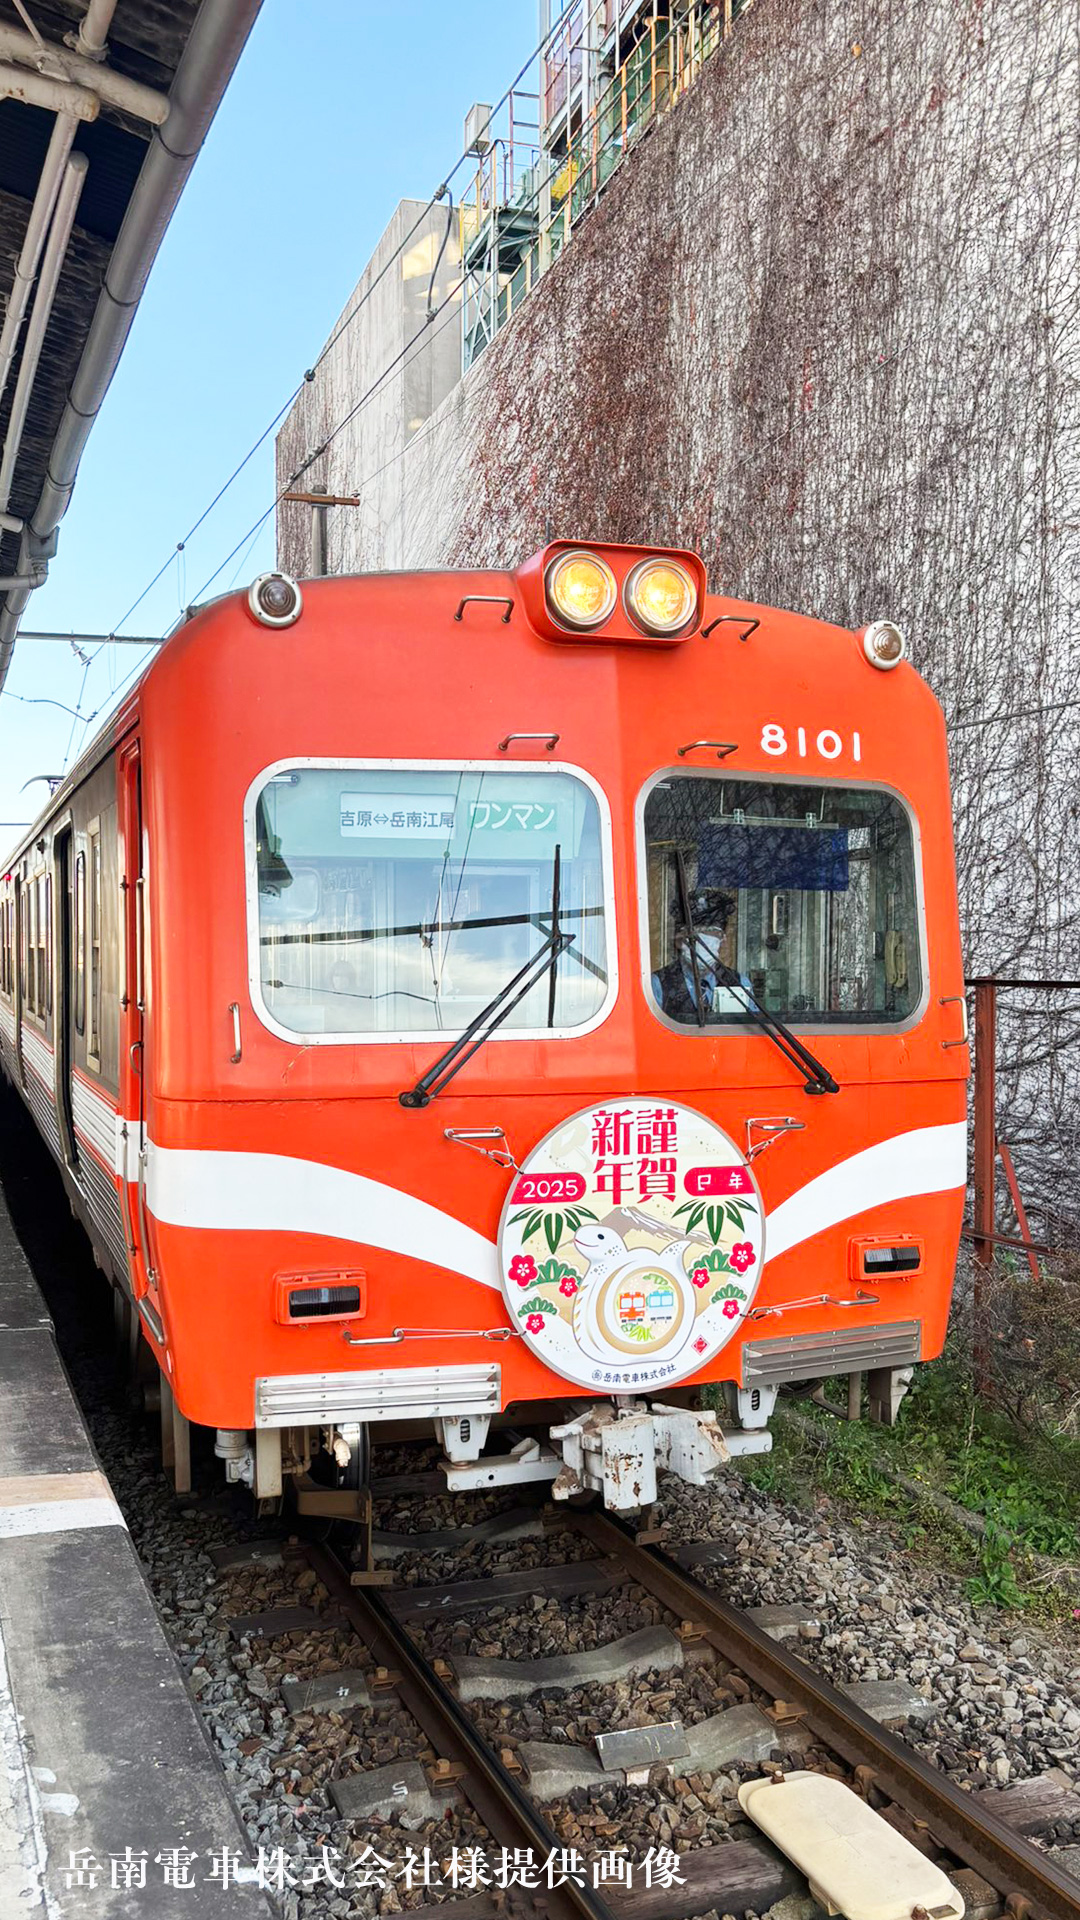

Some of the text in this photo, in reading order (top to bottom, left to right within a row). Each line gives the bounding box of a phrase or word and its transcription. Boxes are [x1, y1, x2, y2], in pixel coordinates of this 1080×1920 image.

[760, 723, 861, 762] 8101
[470, 803, 555, 830] ワンマン
[522, 1179, 579, 1199] 2025
[603, 1363, 677, 1384] 岳南電車株式会社
